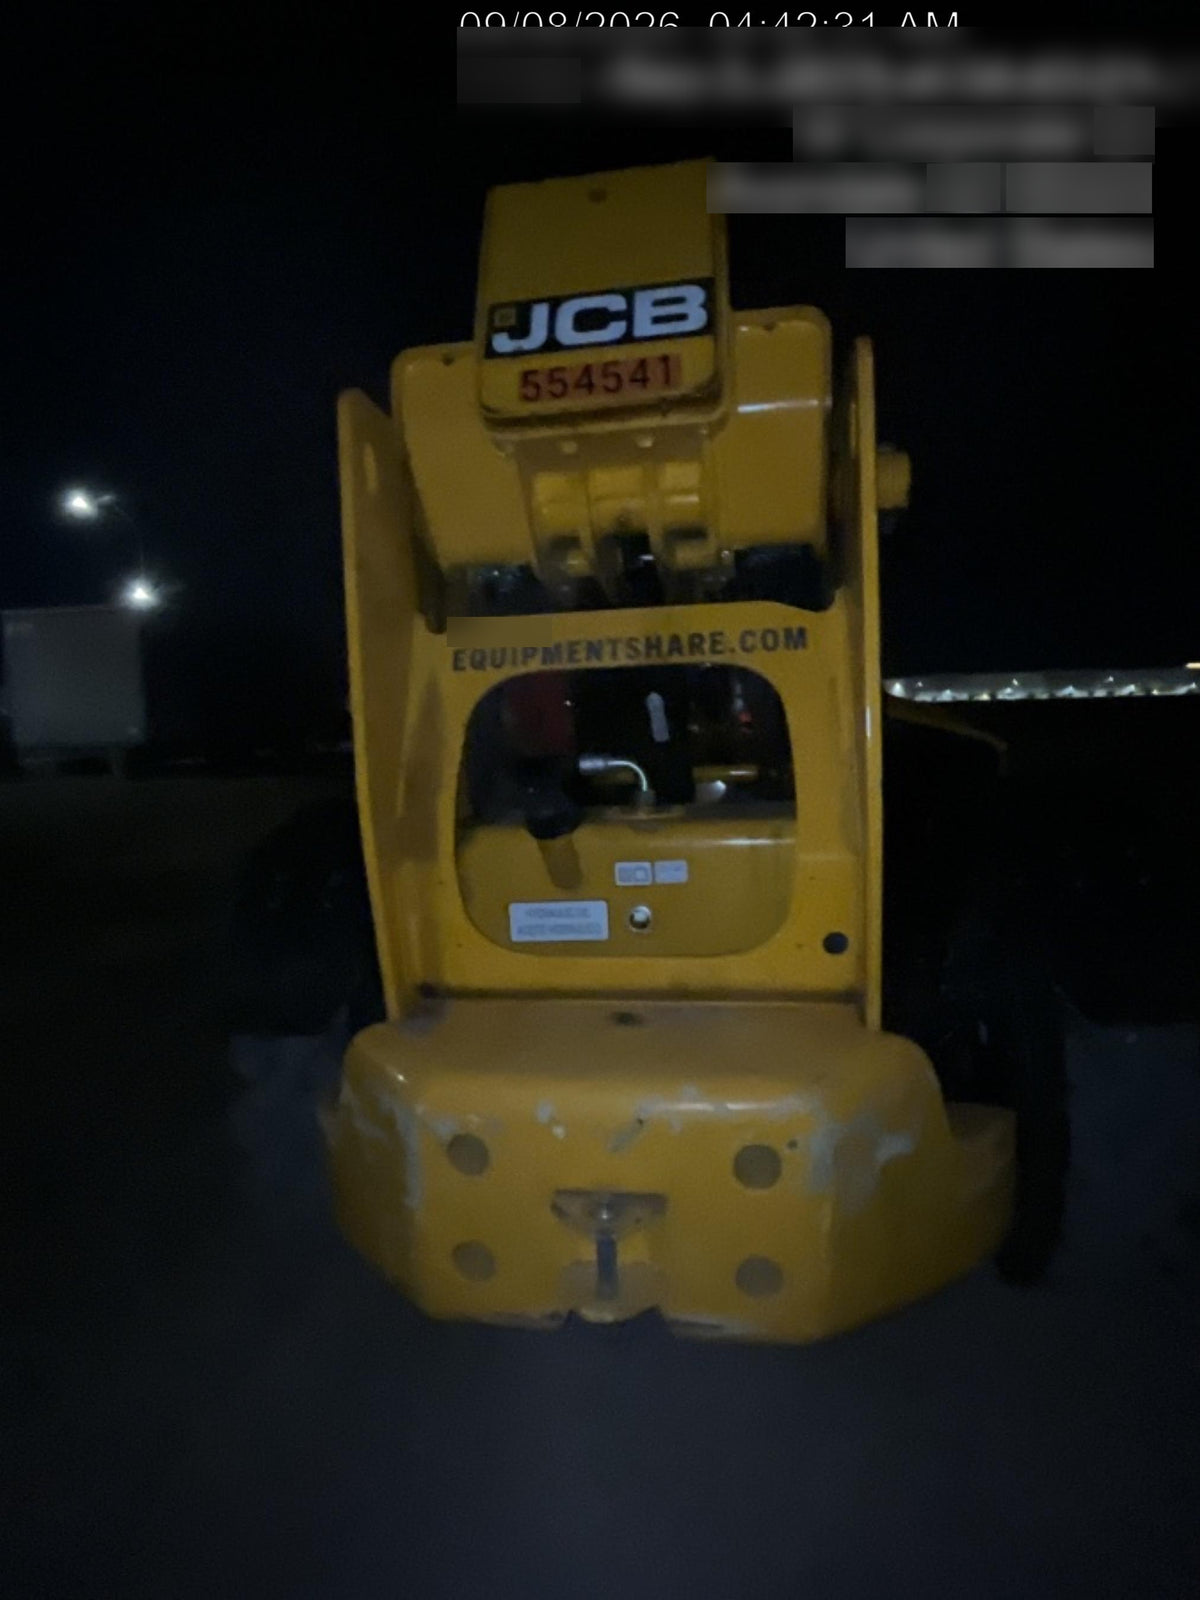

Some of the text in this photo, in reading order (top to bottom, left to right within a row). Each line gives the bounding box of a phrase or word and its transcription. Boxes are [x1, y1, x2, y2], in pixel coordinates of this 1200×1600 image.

[491, 284, 709, 354] JCB
[520, 355, 671, 401] 554541
[452, 626, 808, 672] EQUIPMENTSHARE.COM
